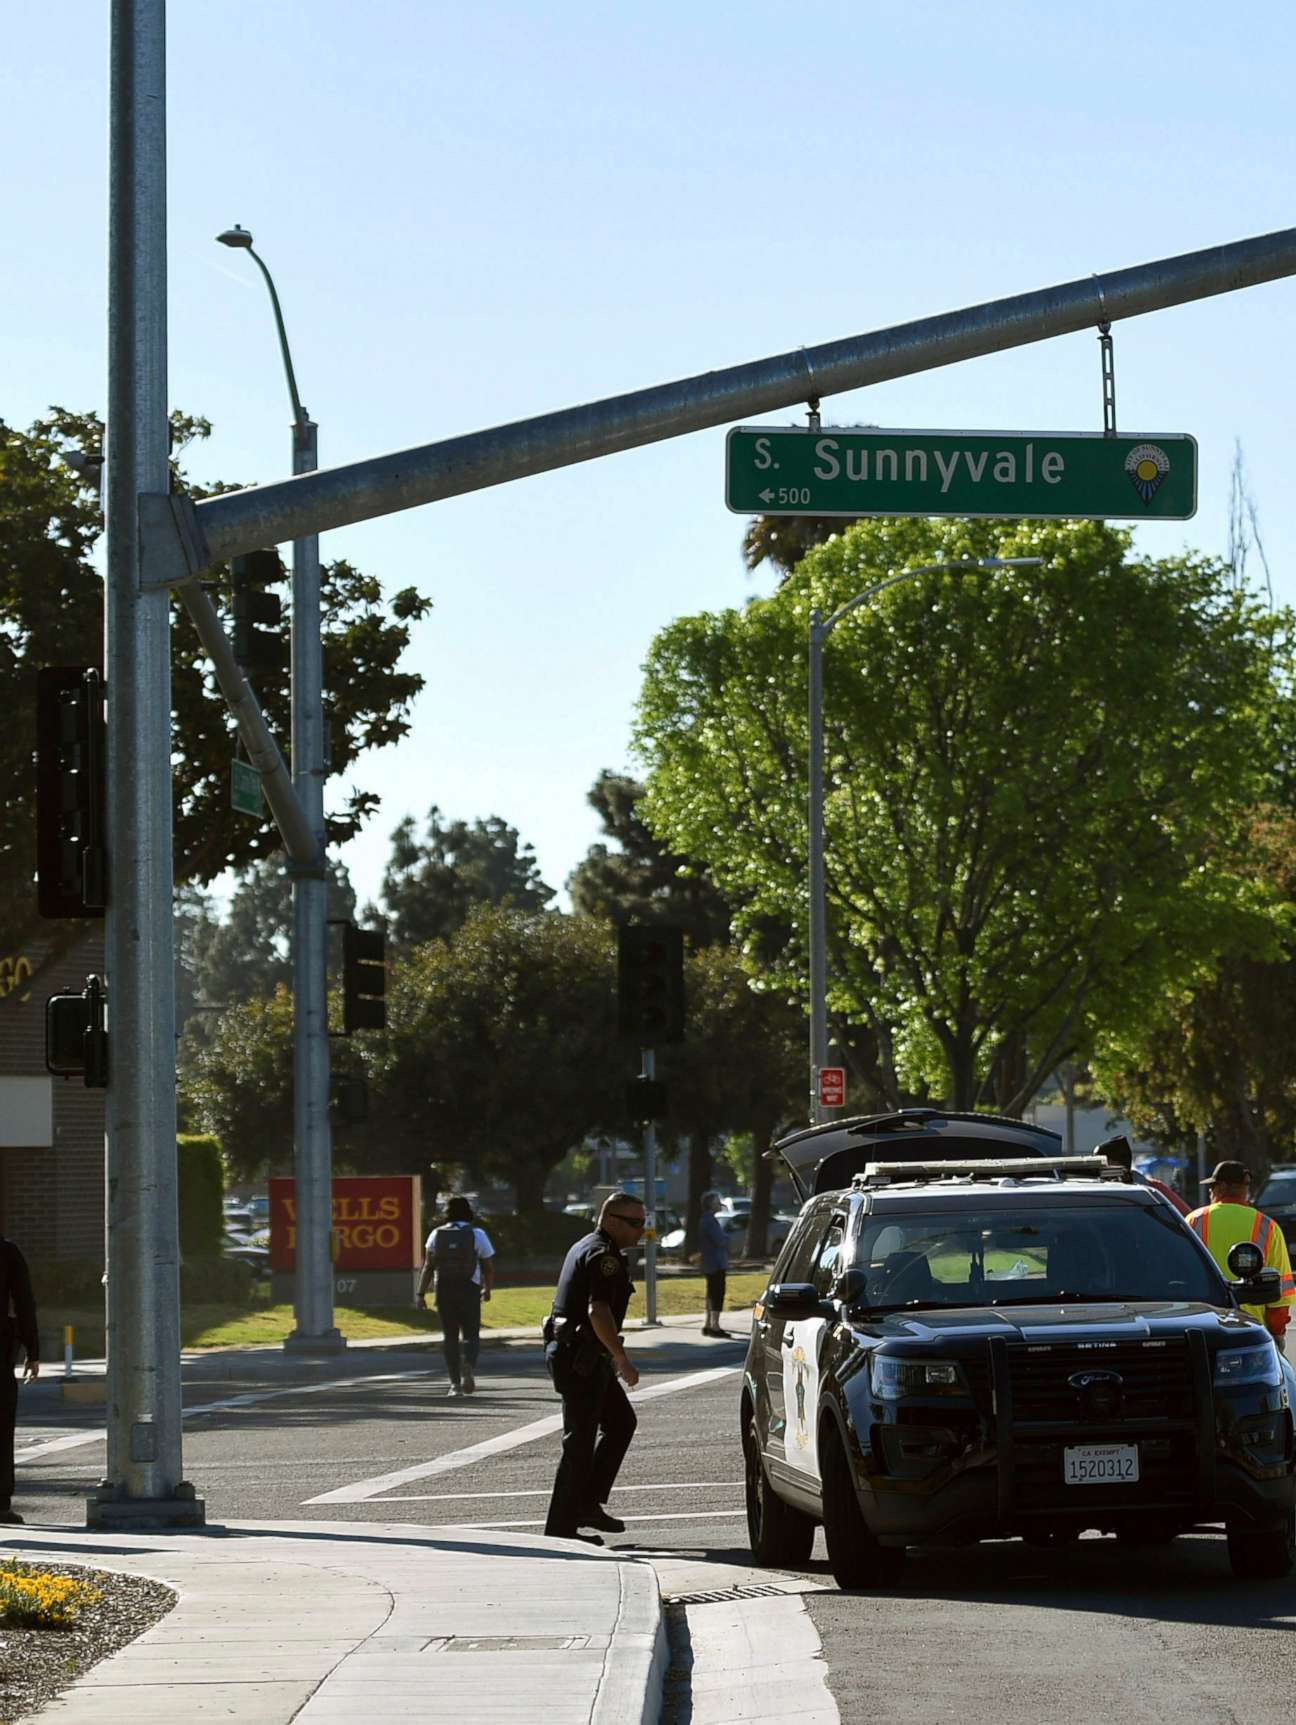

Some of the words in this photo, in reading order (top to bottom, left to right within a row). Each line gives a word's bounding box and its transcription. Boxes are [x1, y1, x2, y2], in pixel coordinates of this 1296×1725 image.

[754, 438, 780, 469] S.
[814, 438, 1065, 493] Sunnyvale
[778, 487, 811, 505] 500
[282, 1197, 400, 1221] LLS
[286, 1225, 400, 1249] RGO
[1070, 1458, 1134, 1479] 1520312
